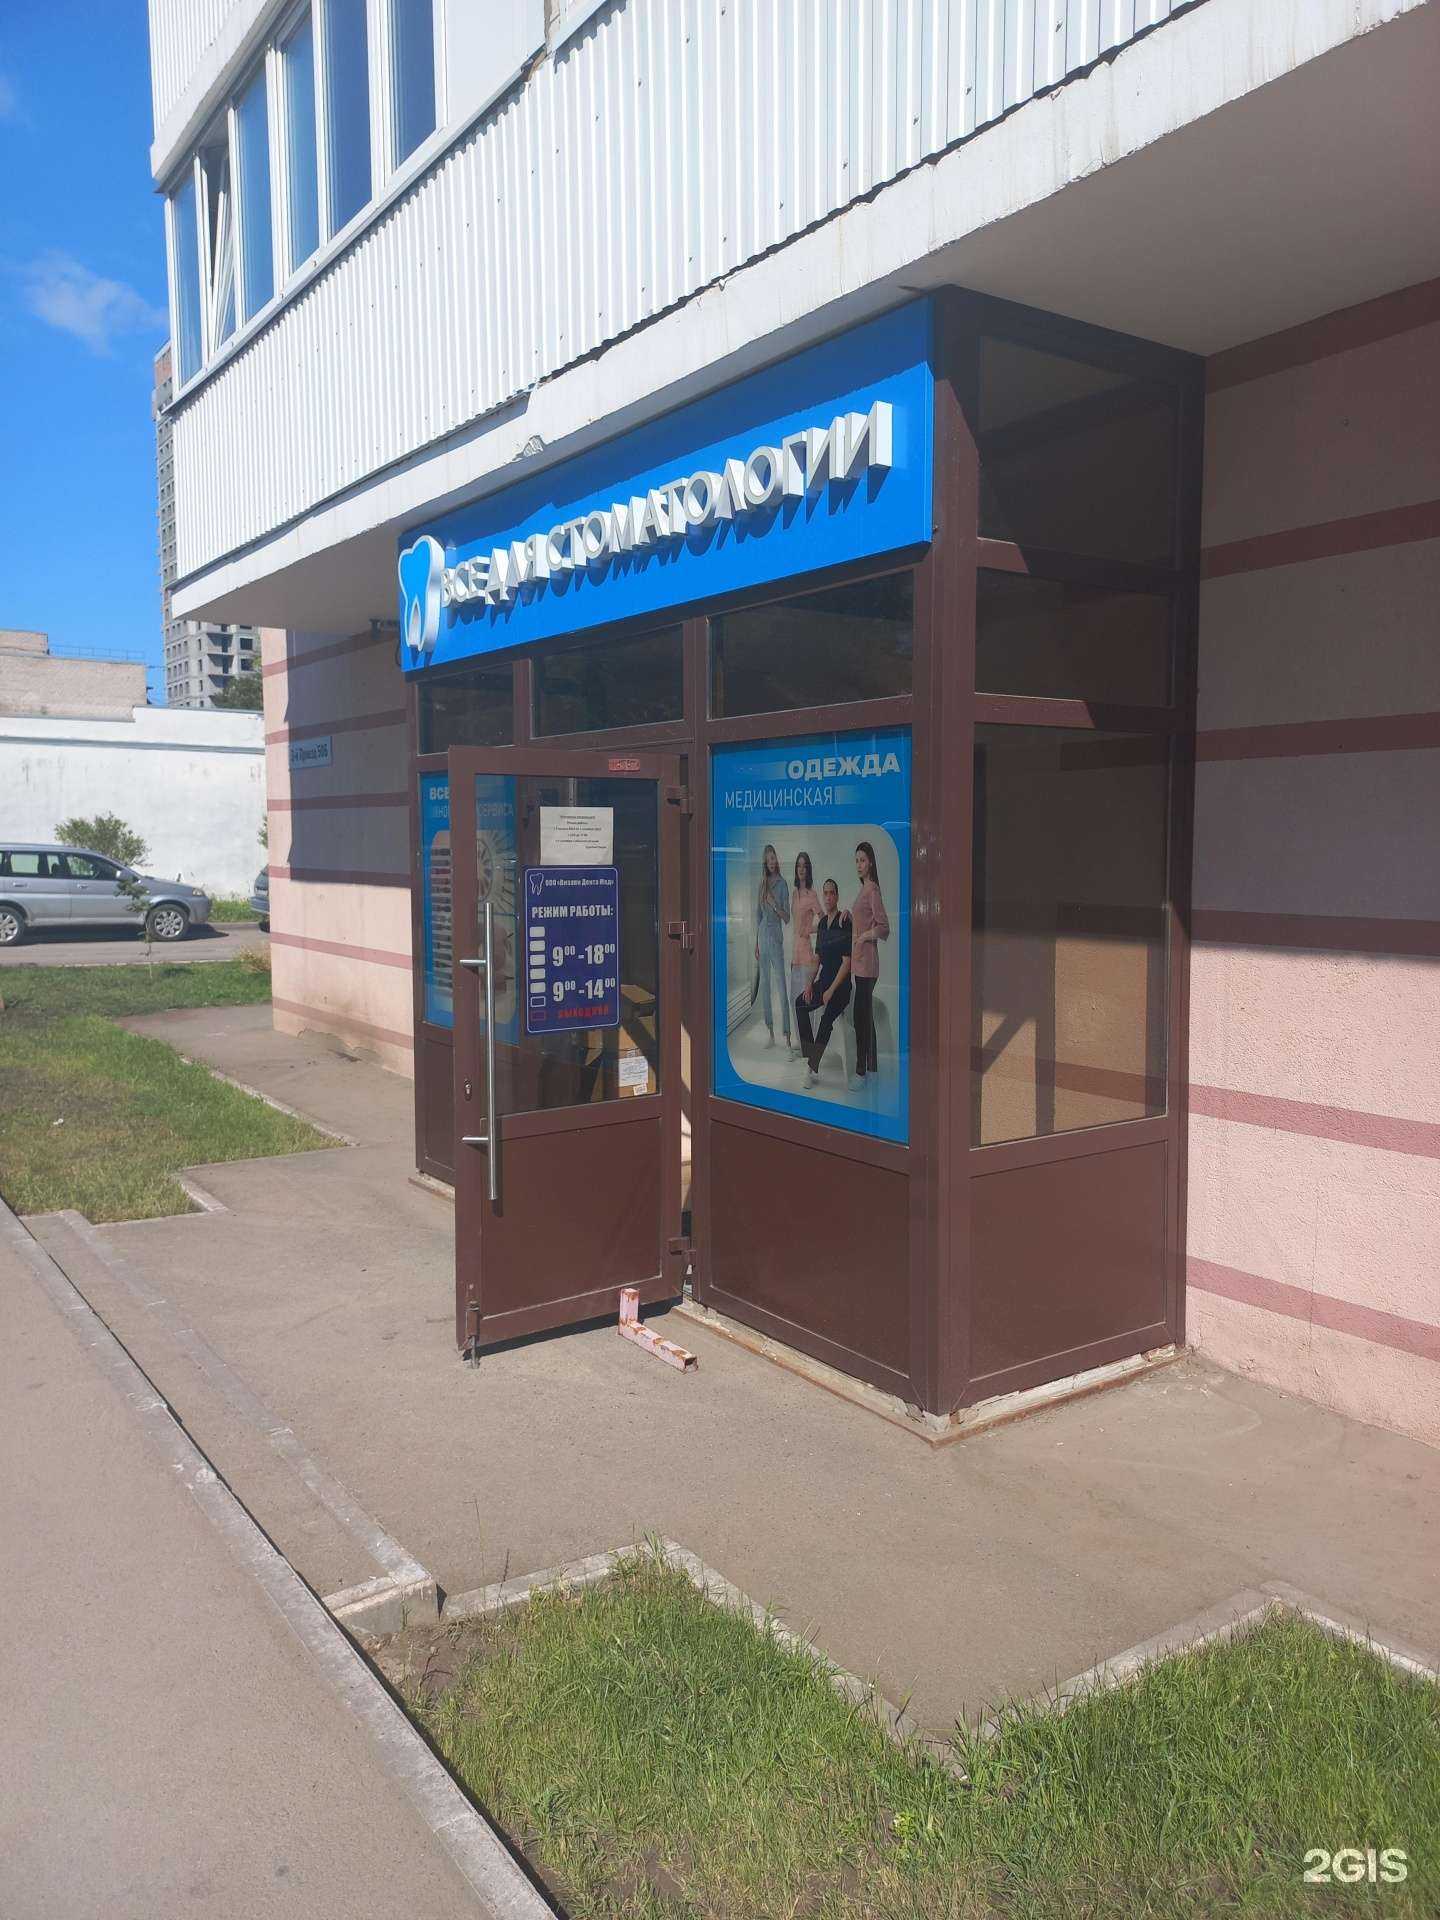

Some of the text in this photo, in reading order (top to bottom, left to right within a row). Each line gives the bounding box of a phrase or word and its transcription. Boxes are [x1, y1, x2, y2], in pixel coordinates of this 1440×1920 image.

[440, 400, 893, 607] ВСЕ ДЛЯ СТОМАТОЛОГИИ
[788, 753, 901, 781] ОДЕЖДА
[725, 786, 833, 811] МЕДИЦИНСКАЯ
[532, 904, 614, 919] РЕЖИМ РАБОТЫ:
